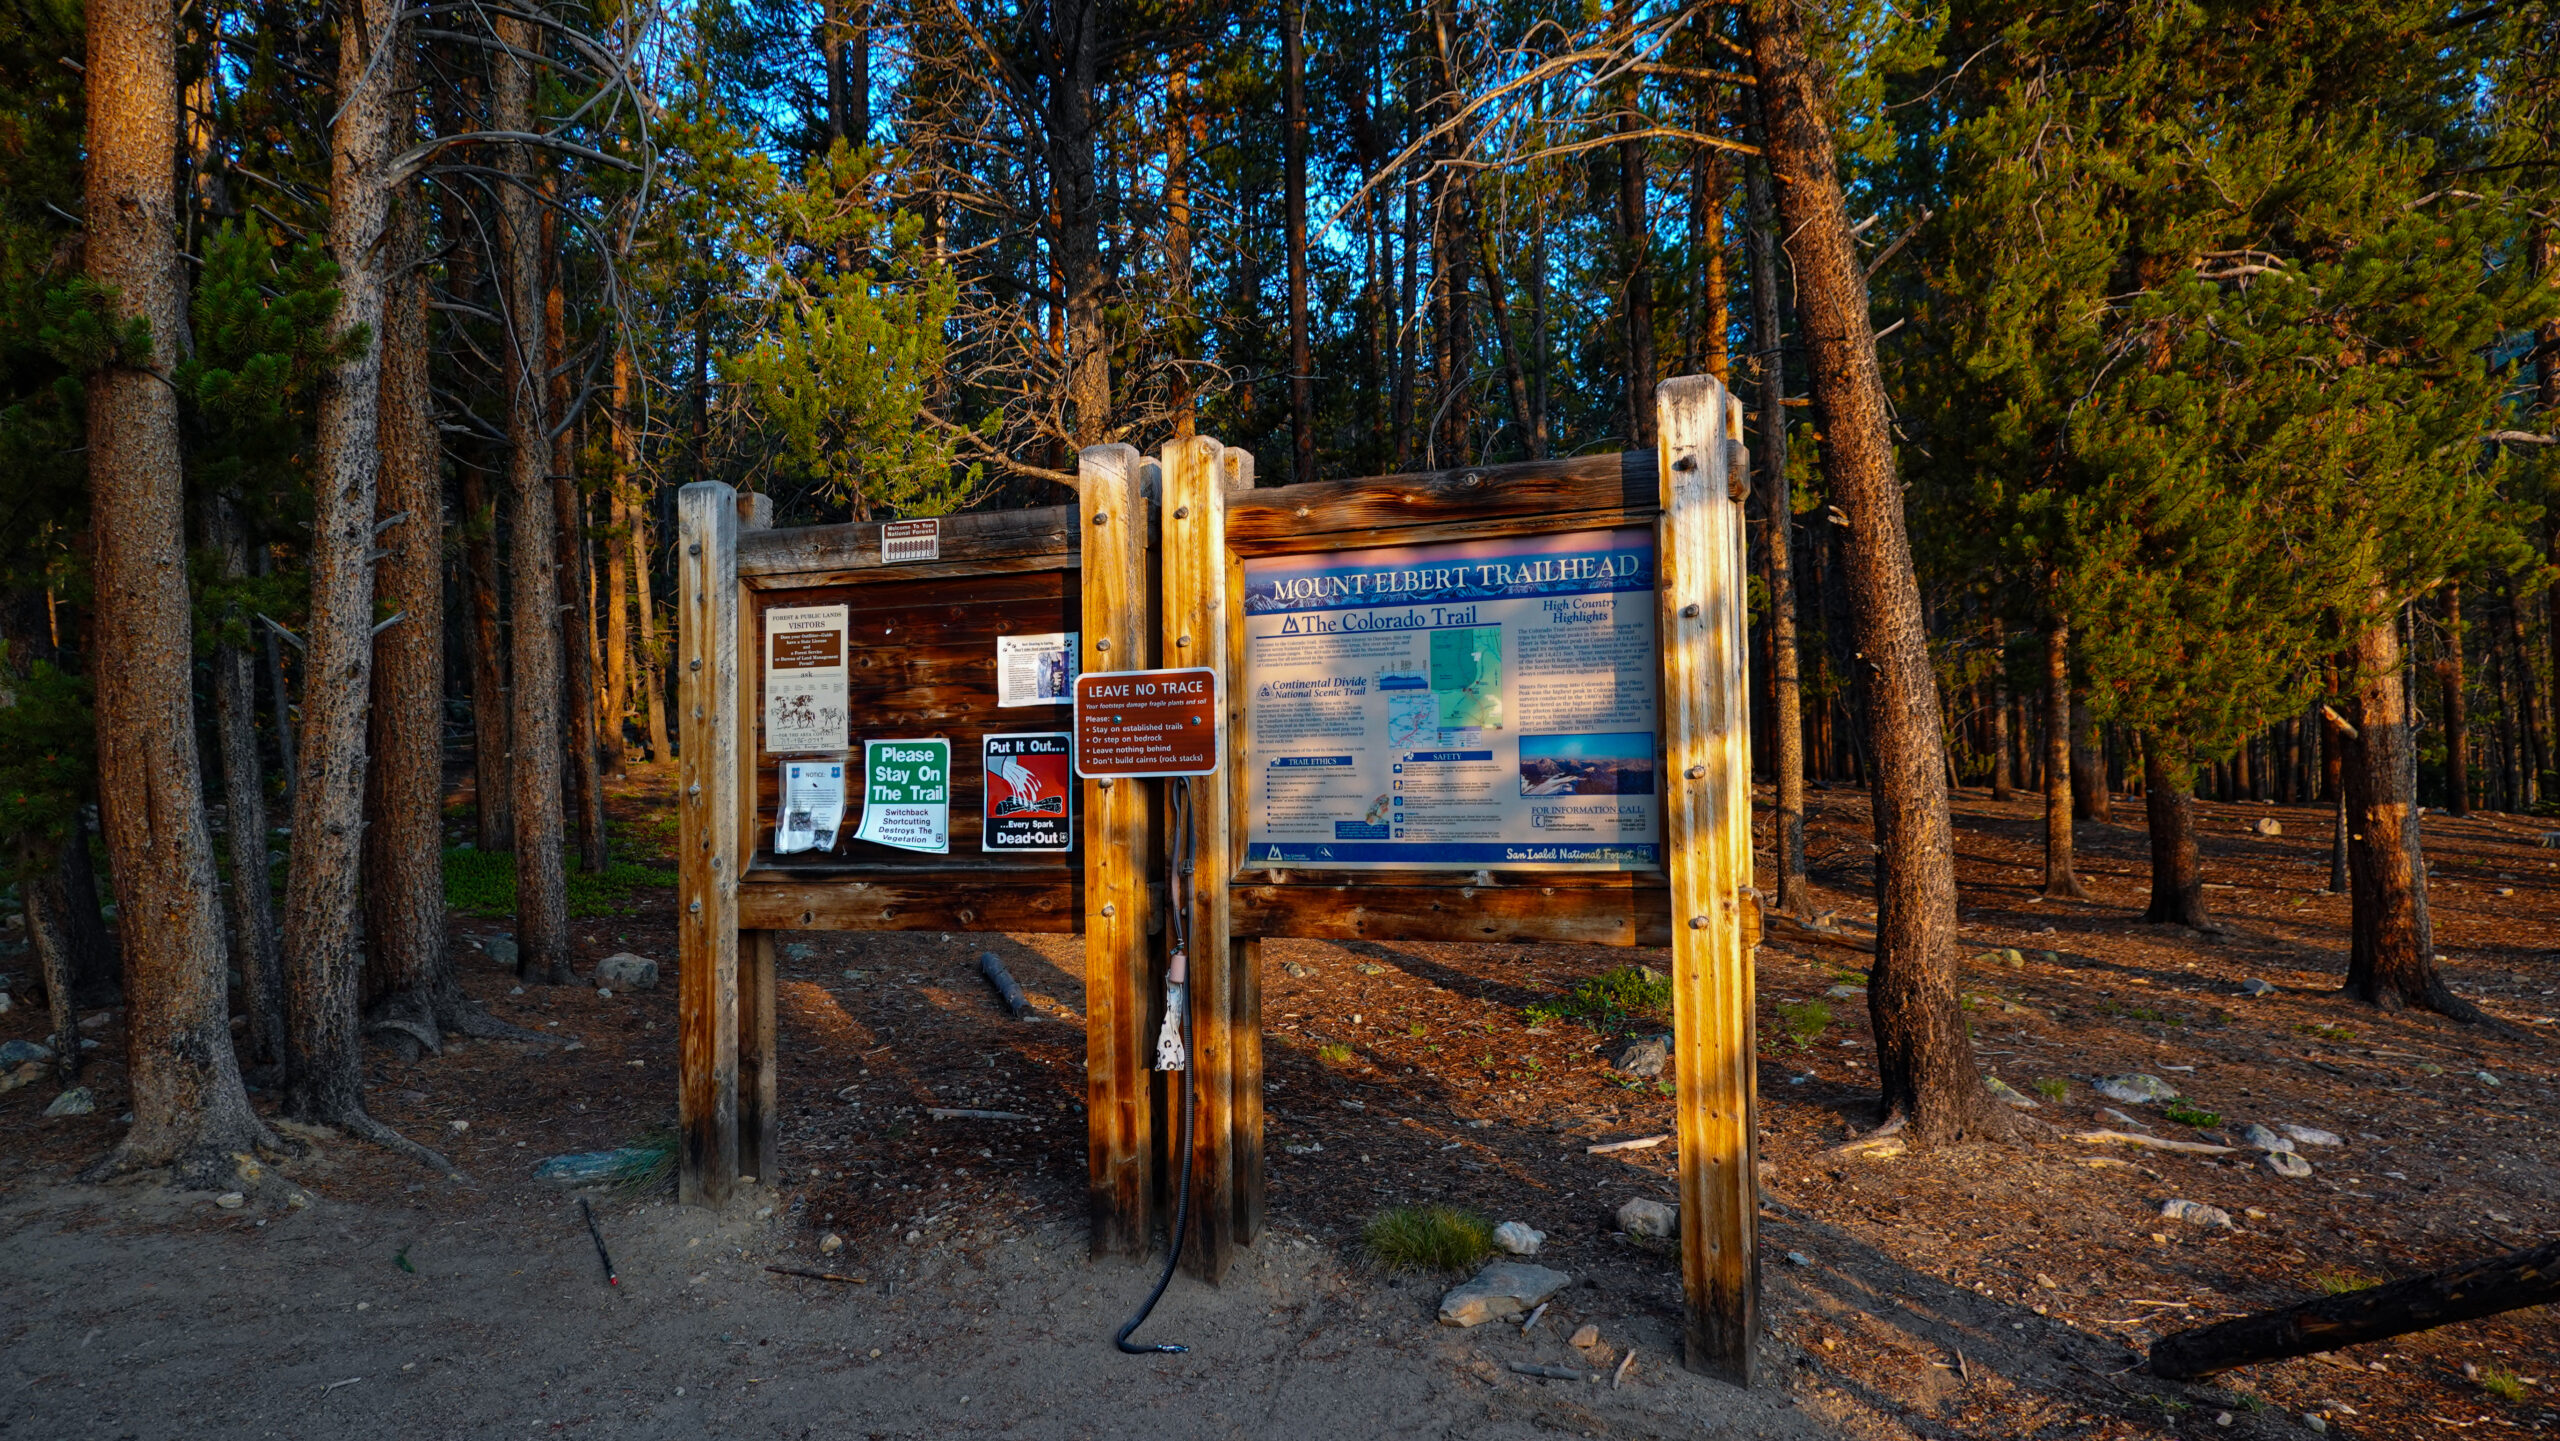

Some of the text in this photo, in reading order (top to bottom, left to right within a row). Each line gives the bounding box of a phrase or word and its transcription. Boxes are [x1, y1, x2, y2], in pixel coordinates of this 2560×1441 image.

[1274, 555, 1639, 600] MOUNT ELBERT TRAILHEAD
[1544, 599, 1618, 612] High Country
[1302, 606, 1477, 634] The Colorado Trail
[1553, 611, 1608, 625] Highlights
[1089, 681, 1203, 698] LEAVE NO TRACE
[1273, 677, 1367, 690] Continental Divide
[1275, 687, 1366, 699] National Scenic Trail
[990, 740, 1064, 753] Put It Out...
[882, 747, 934, 762] Please
[1180, 754, 1203, 762] stacks)
[875, 766, 940, 784] Stay On
[873, 785, 943, 801] The Trail
[879, 827, 914, 835] Destroys
[1001, 820, 1054, 829] ...Every Spark
[883, 835, 926, 843] Vegetation
[997, 832, 1058, 844] Dead-Out
[1506, 848, 1634, 860] San Isabel National Forest
